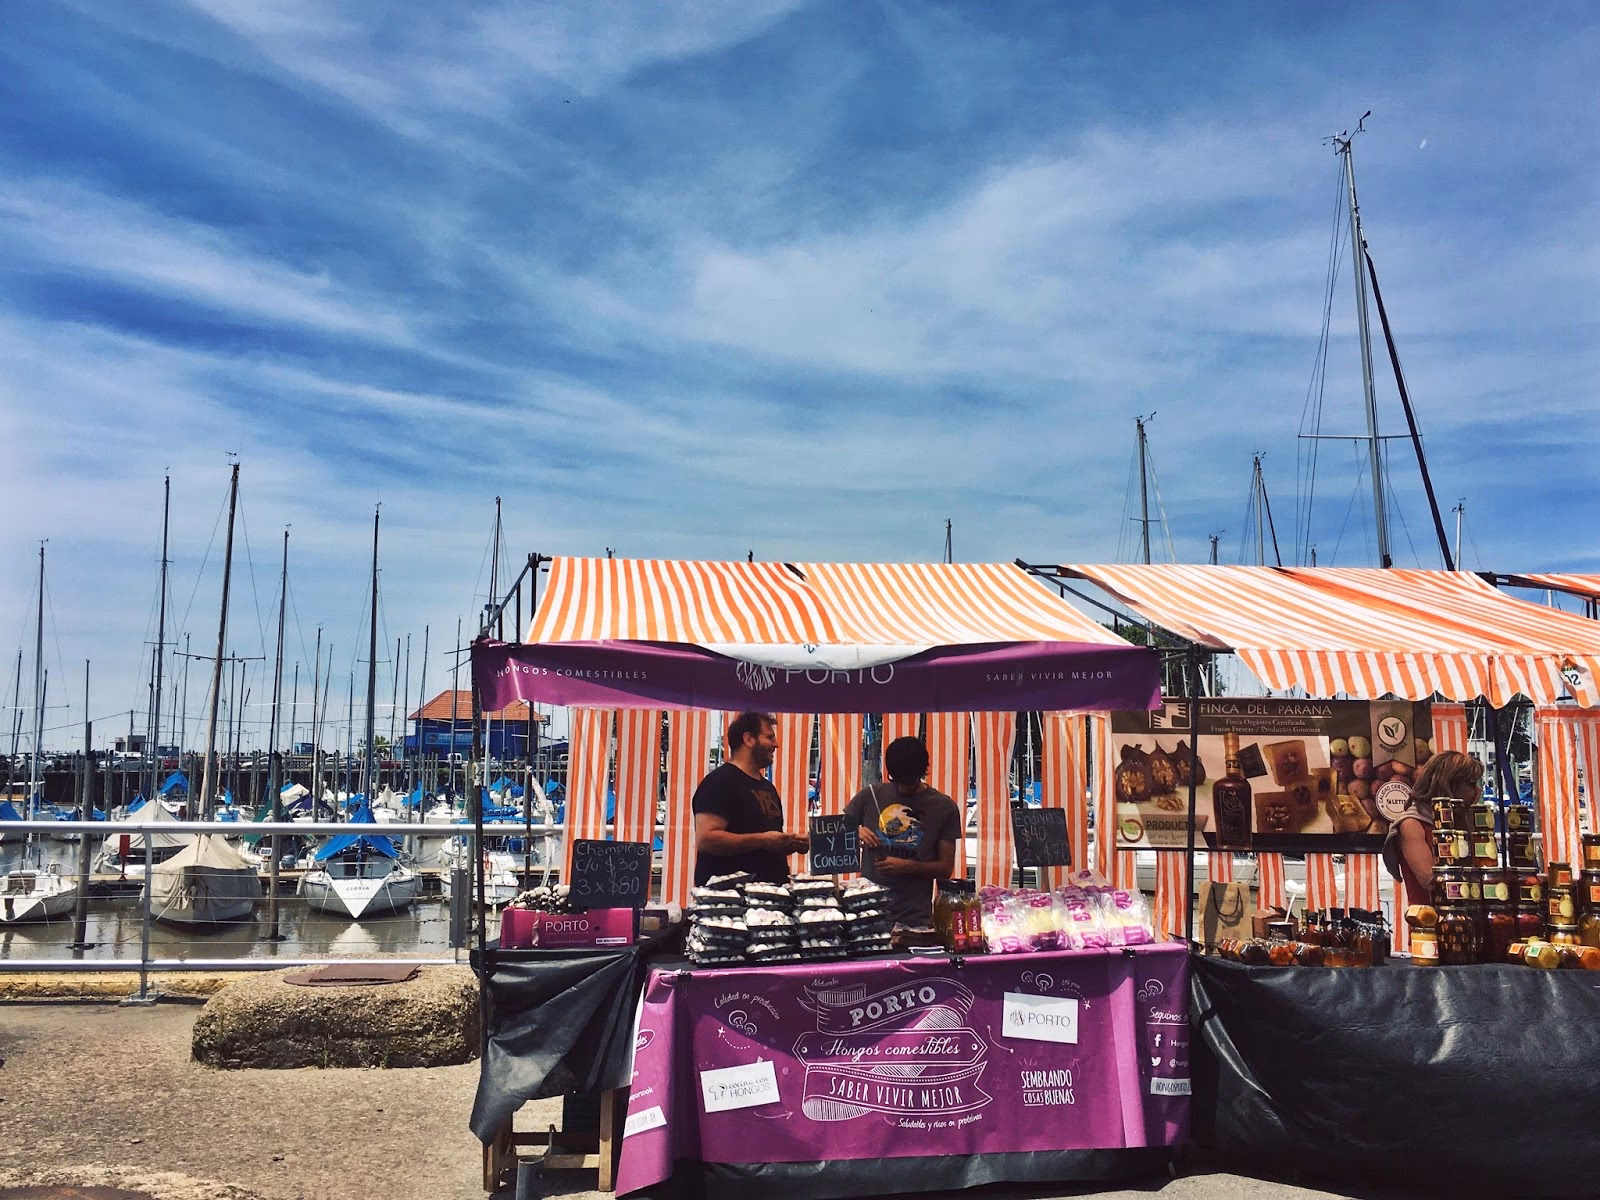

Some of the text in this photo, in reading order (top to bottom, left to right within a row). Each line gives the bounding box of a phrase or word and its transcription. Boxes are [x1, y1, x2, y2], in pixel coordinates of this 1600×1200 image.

[496, 666, 647, 679] HONGOS COMESTIBLES
[785, 663, 894, 684] PORTO
[986, 671, 1112, 681] SABER VIVIR MEJOR
[1200, 703, 1333, 715] FINCA DEL PARANA
[576, 878, 591, 895] 3
[545, 919, 589, 931] PORTO
[714, 991, 740, 1009] Calidad
[849, 986, 936, 1027] PORTO
[1028, 1012, 1071, 1028] PORTO
[820, 1036, 961, 1063] Hongos comestibles
[1020, 1069, 1073, 1089] SEMBRANDO
[730, 1083, 772, 1098] HONGOS
[829, 1076, 963, 1109] SABER VIVIR MEJOR
[1023, 1088, 1075, 1105] COSAS BUENAS
[898, 1117, 926, 1129] Saludables
